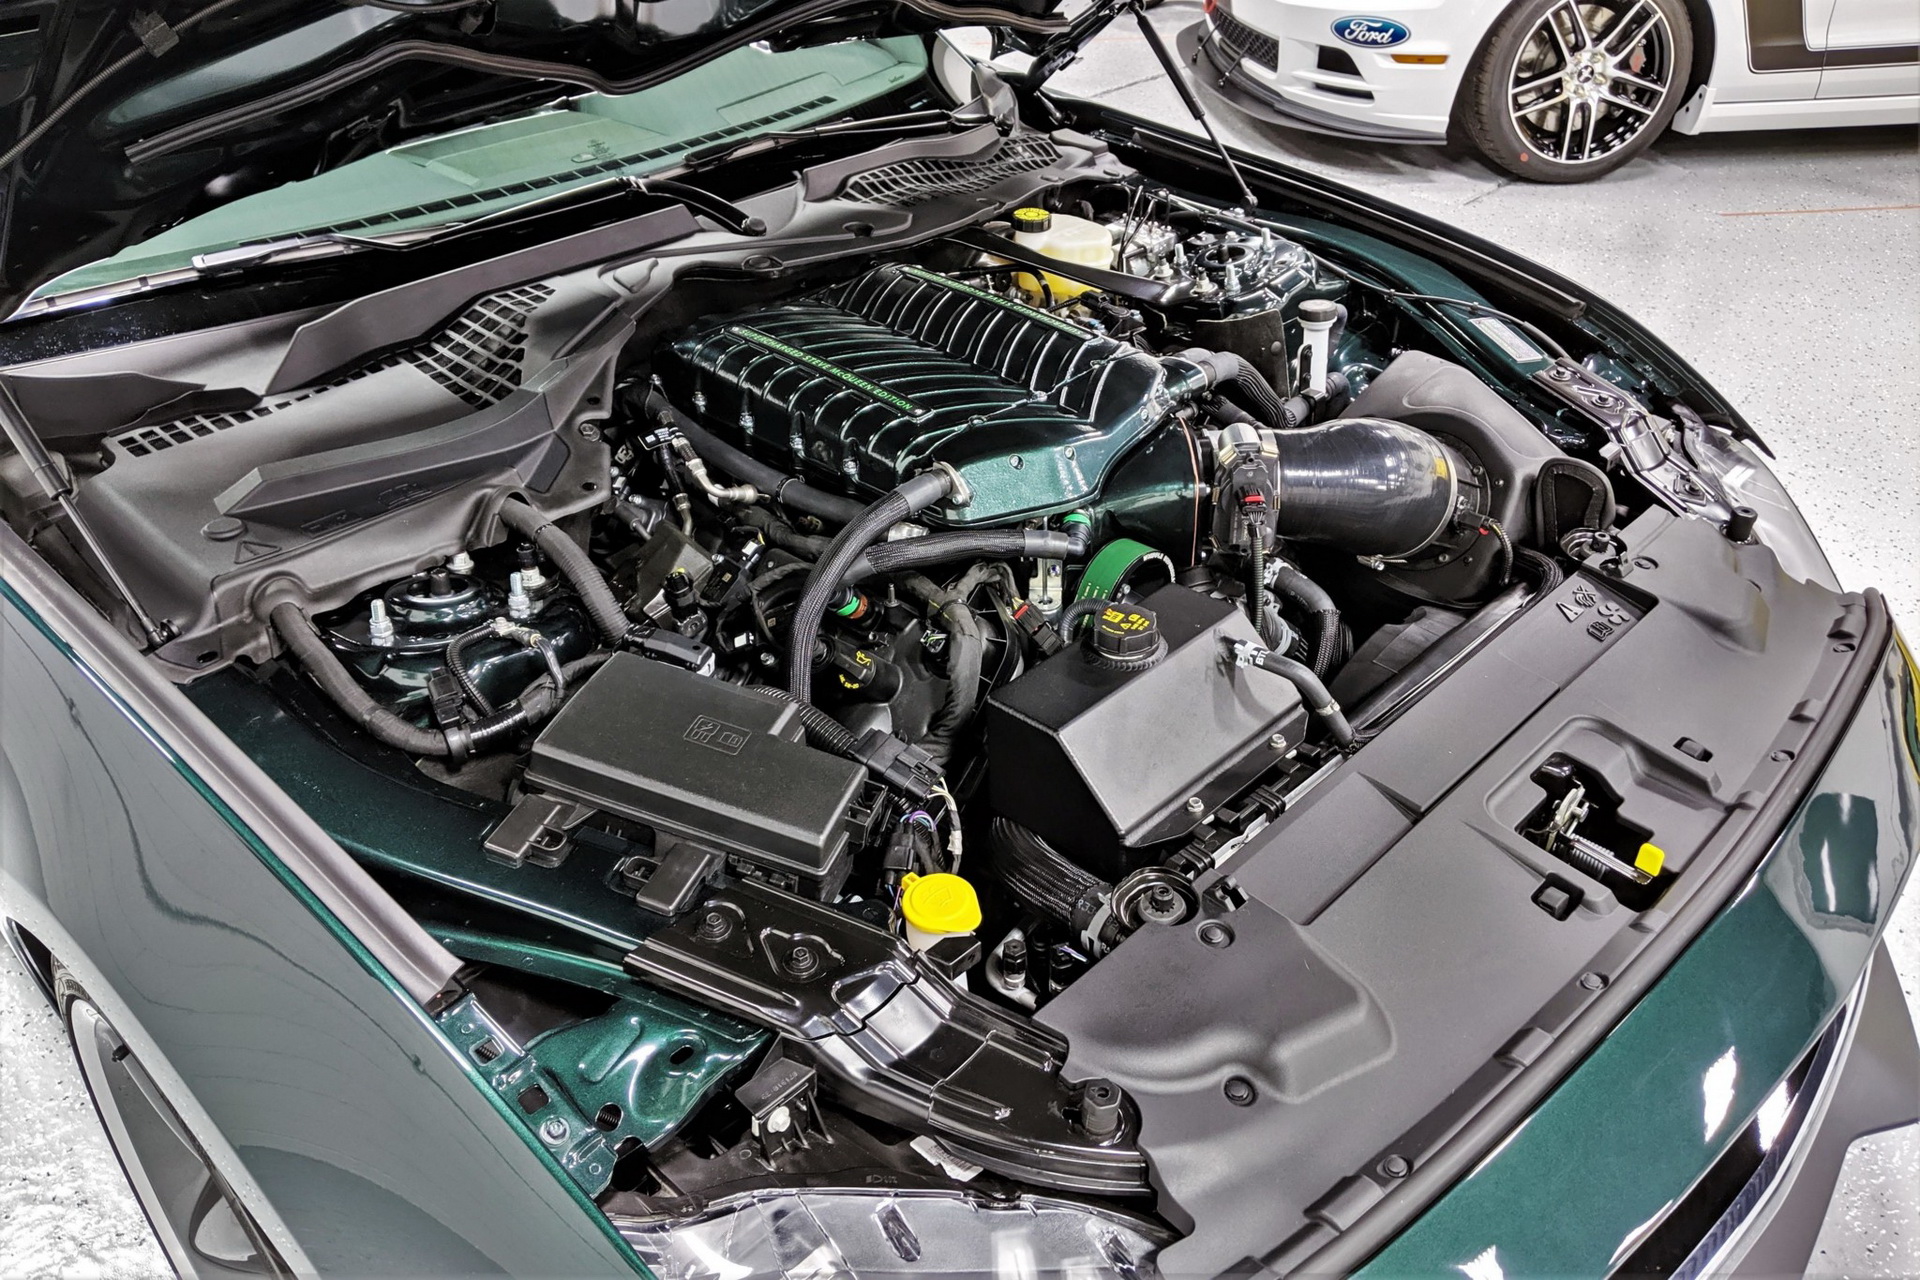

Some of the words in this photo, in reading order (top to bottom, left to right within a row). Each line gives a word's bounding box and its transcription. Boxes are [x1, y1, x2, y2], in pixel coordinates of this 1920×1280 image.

[1344, 19, 1395, 44] Ford
[740, 329, 804, 358] SUPERCHARGED
[802, 355, 832, 371] STEVE
[873, 388, 913, 410] EDITION
